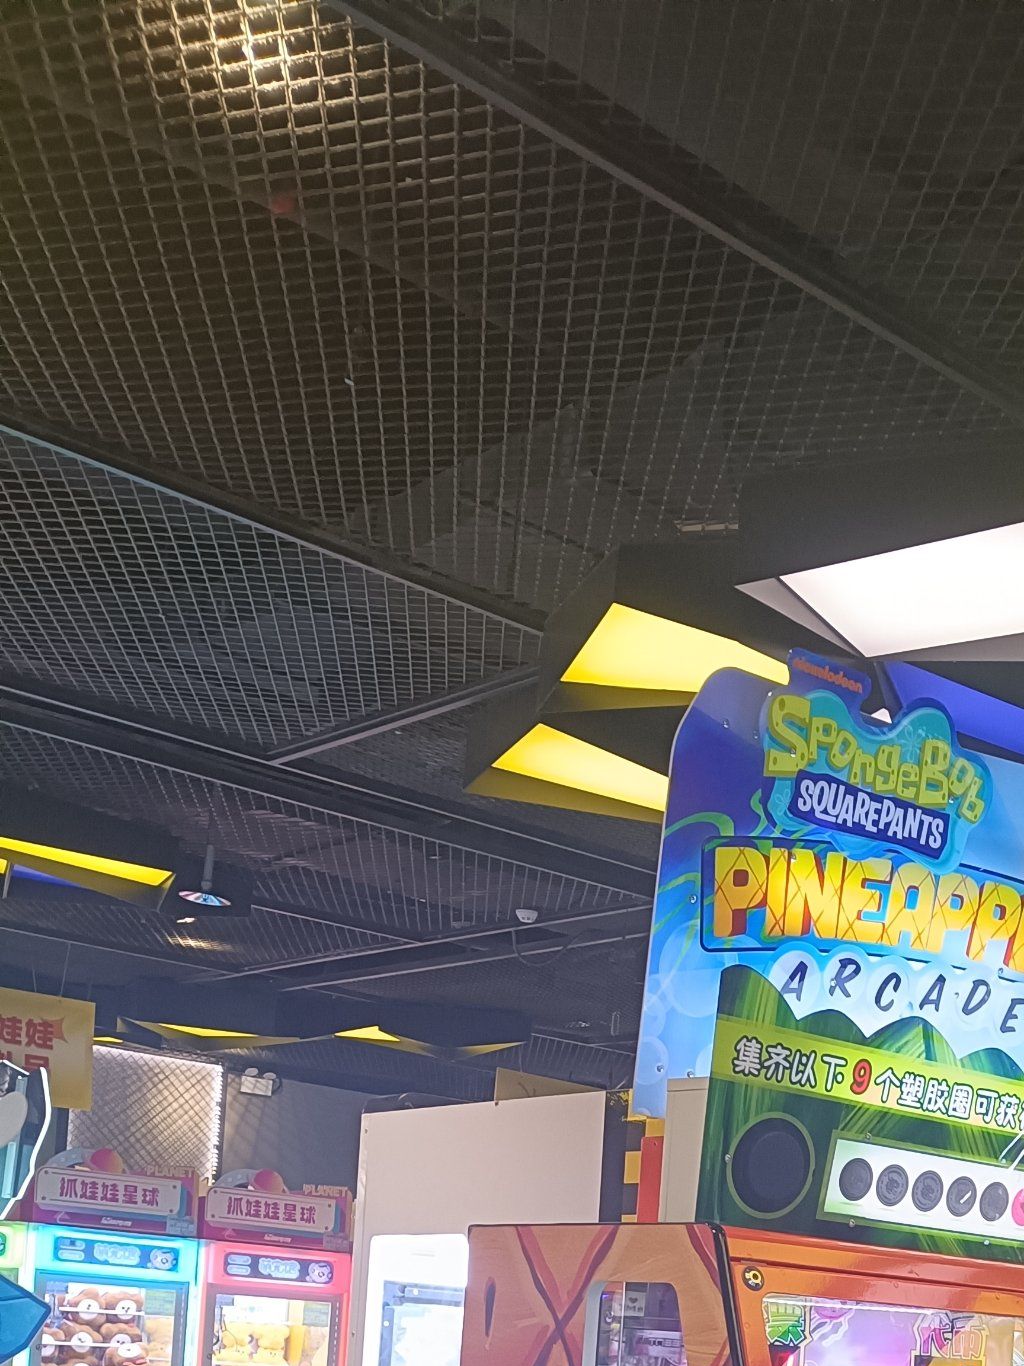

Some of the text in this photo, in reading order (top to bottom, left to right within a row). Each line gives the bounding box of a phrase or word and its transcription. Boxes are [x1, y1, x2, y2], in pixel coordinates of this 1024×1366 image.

[764, 696, 986, 824] SpongeBob
[797, 779, 945, 849] SQUAREPANTS
[59, 1177, 160, 1207] 抓娃娃星球
[226, 1196, 317, 1225] 抓娃娃星球
[918, 1312, 987, 1359] 代币
